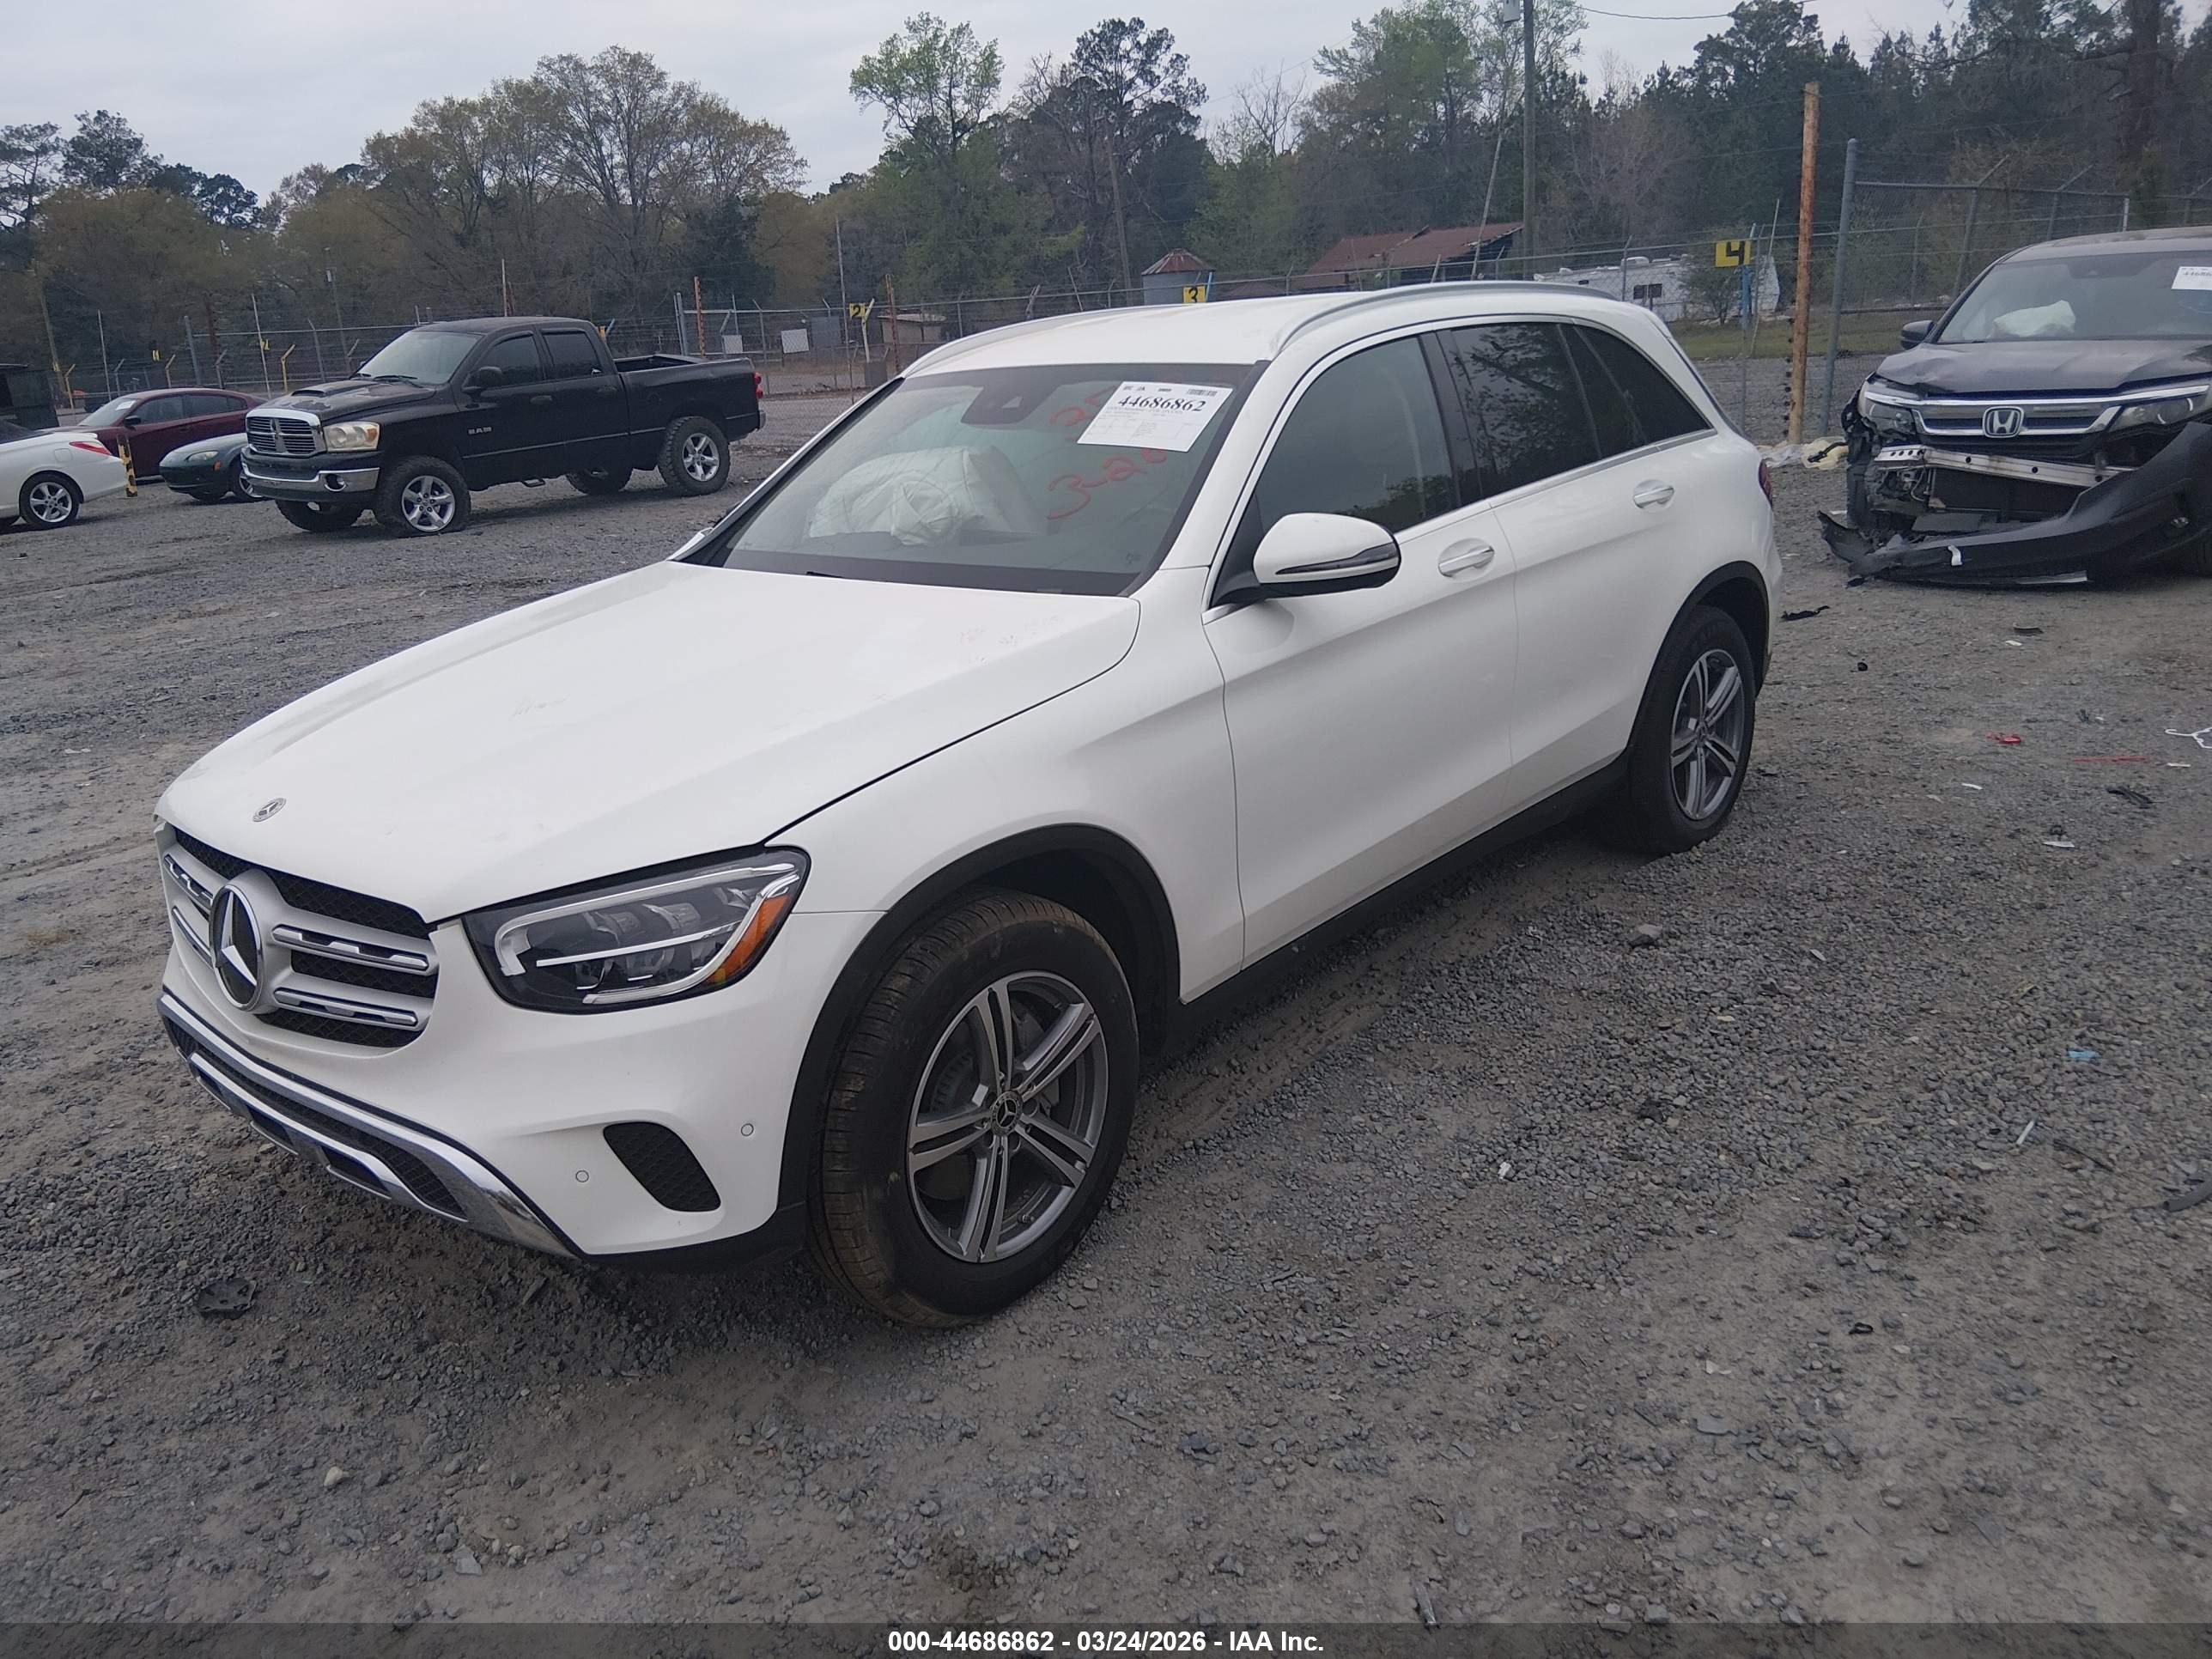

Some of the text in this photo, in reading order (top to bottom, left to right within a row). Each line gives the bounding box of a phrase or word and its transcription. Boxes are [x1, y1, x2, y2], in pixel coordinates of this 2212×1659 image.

[1726, 240, 1745, 264] 4
[1188, 286, 1199, 303] 3
[852, 304, 860, 318] 2
[1118, 395, 1206, 412] 44686862
